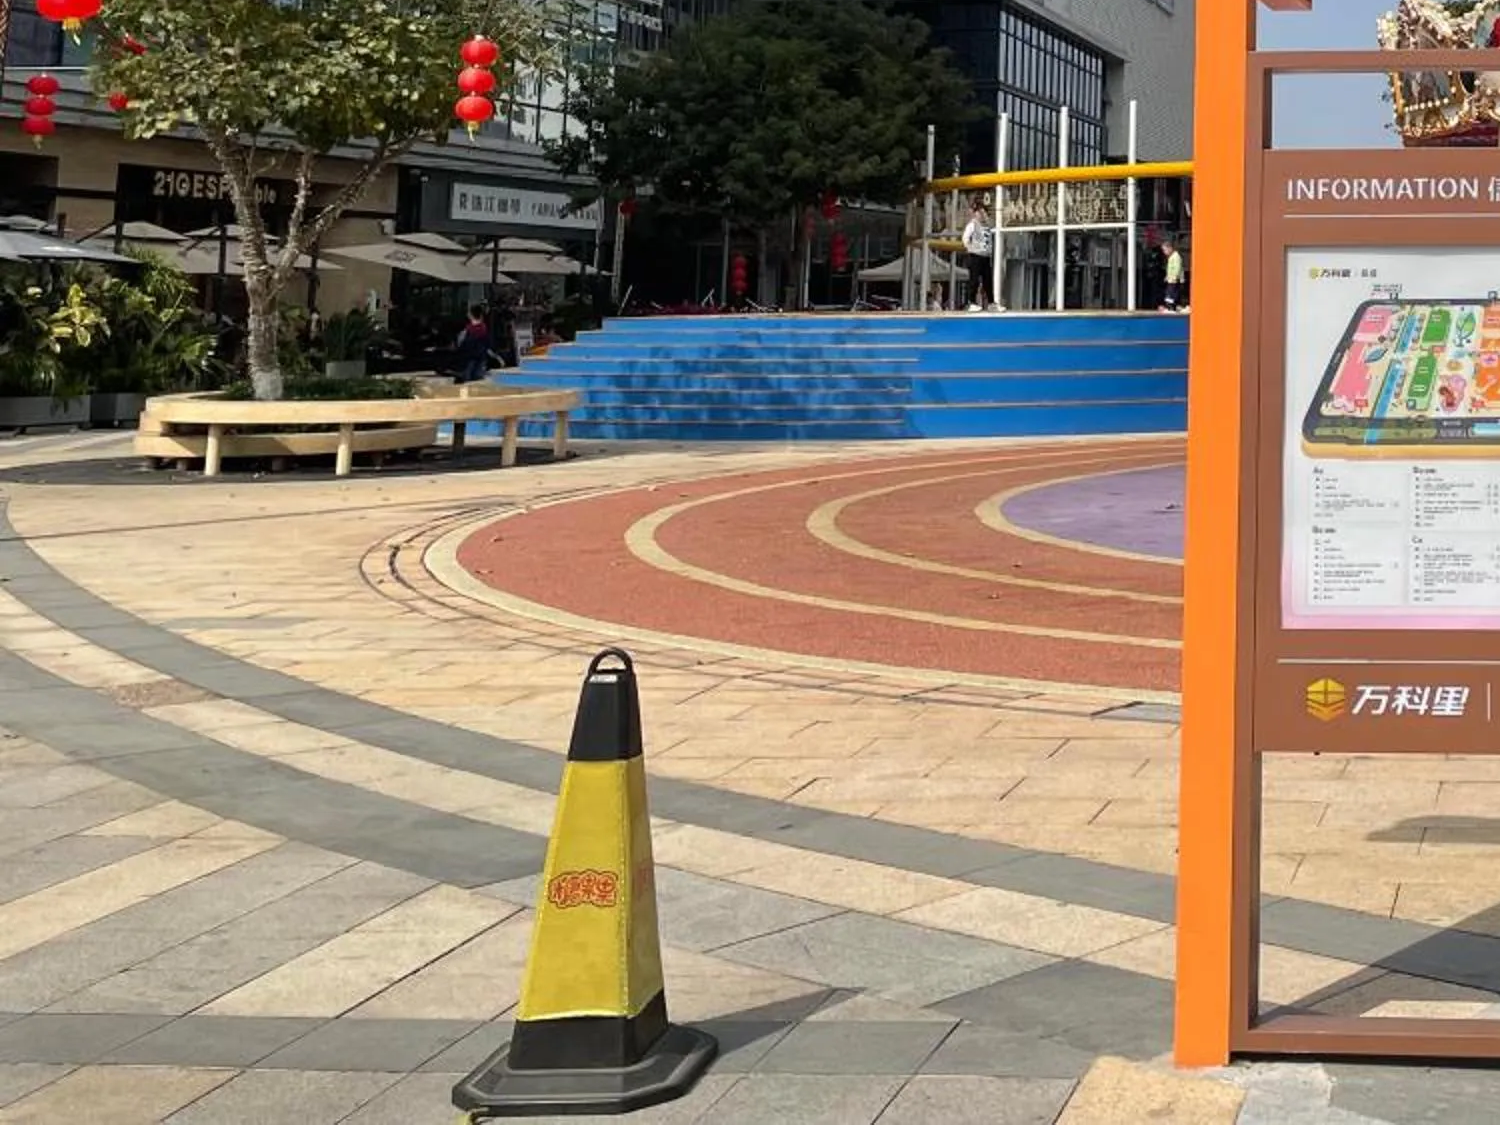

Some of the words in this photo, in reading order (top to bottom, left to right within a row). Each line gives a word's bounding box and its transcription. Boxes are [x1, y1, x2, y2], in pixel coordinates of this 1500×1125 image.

[1286, 176, 1479, 200] INFORMATION
[1351, 684, 1470, 716] 万科里
